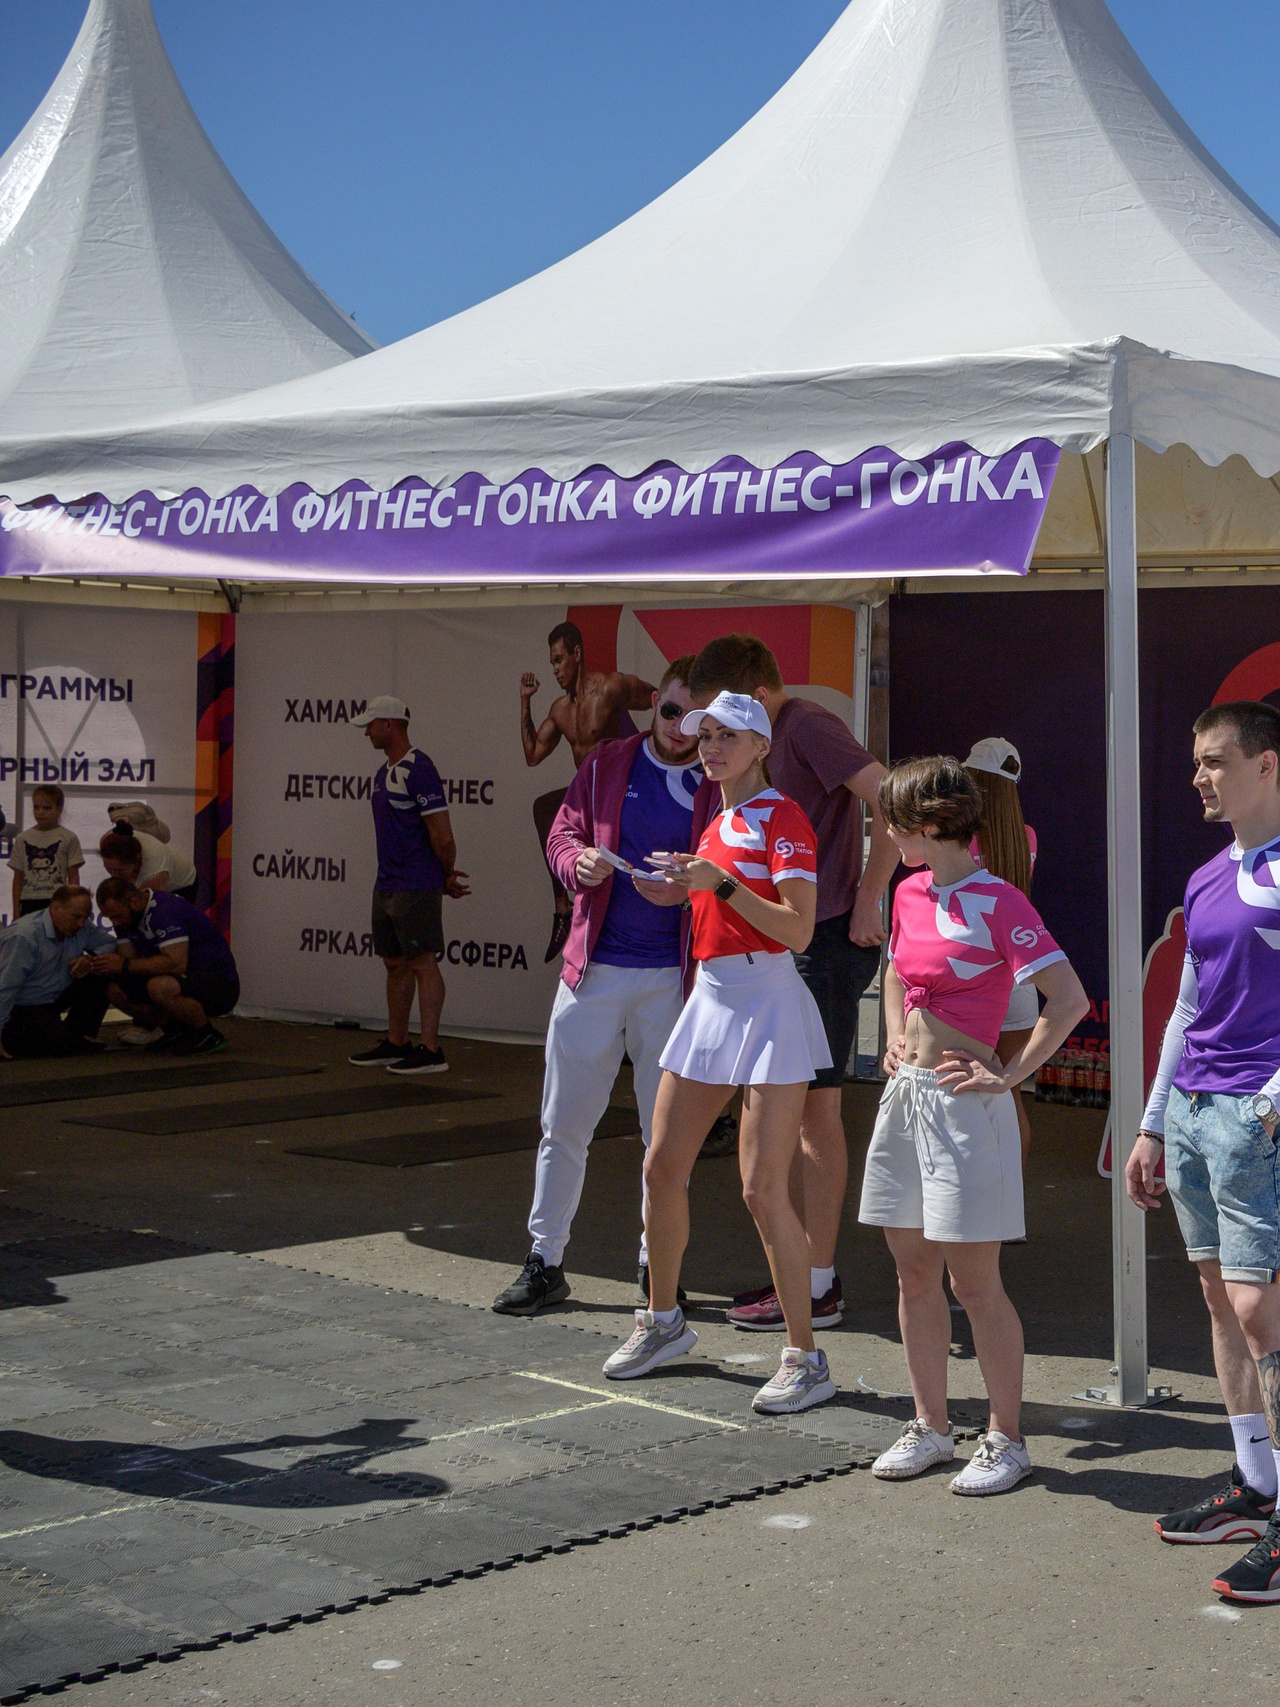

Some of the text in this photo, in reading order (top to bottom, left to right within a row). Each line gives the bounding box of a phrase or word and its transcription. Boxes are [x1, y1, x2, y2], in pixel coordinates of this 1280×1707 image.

[1, 452, 1044, 537] ФИТНЕС-ГОНКА ФИТНЕС-ГОНКА ФИТНЕС-ГОНКА
[0, 674, 133, 702] ГРАММЫ
[0, 751, 155, 782] РНЫЙ ЗАЛ
[284, 774, 372, 802] ДЕТСКИ
[252, 848, 346, 882] САЙКЛЫ
[300, 928, 374, 957] ЯРКАЯ
